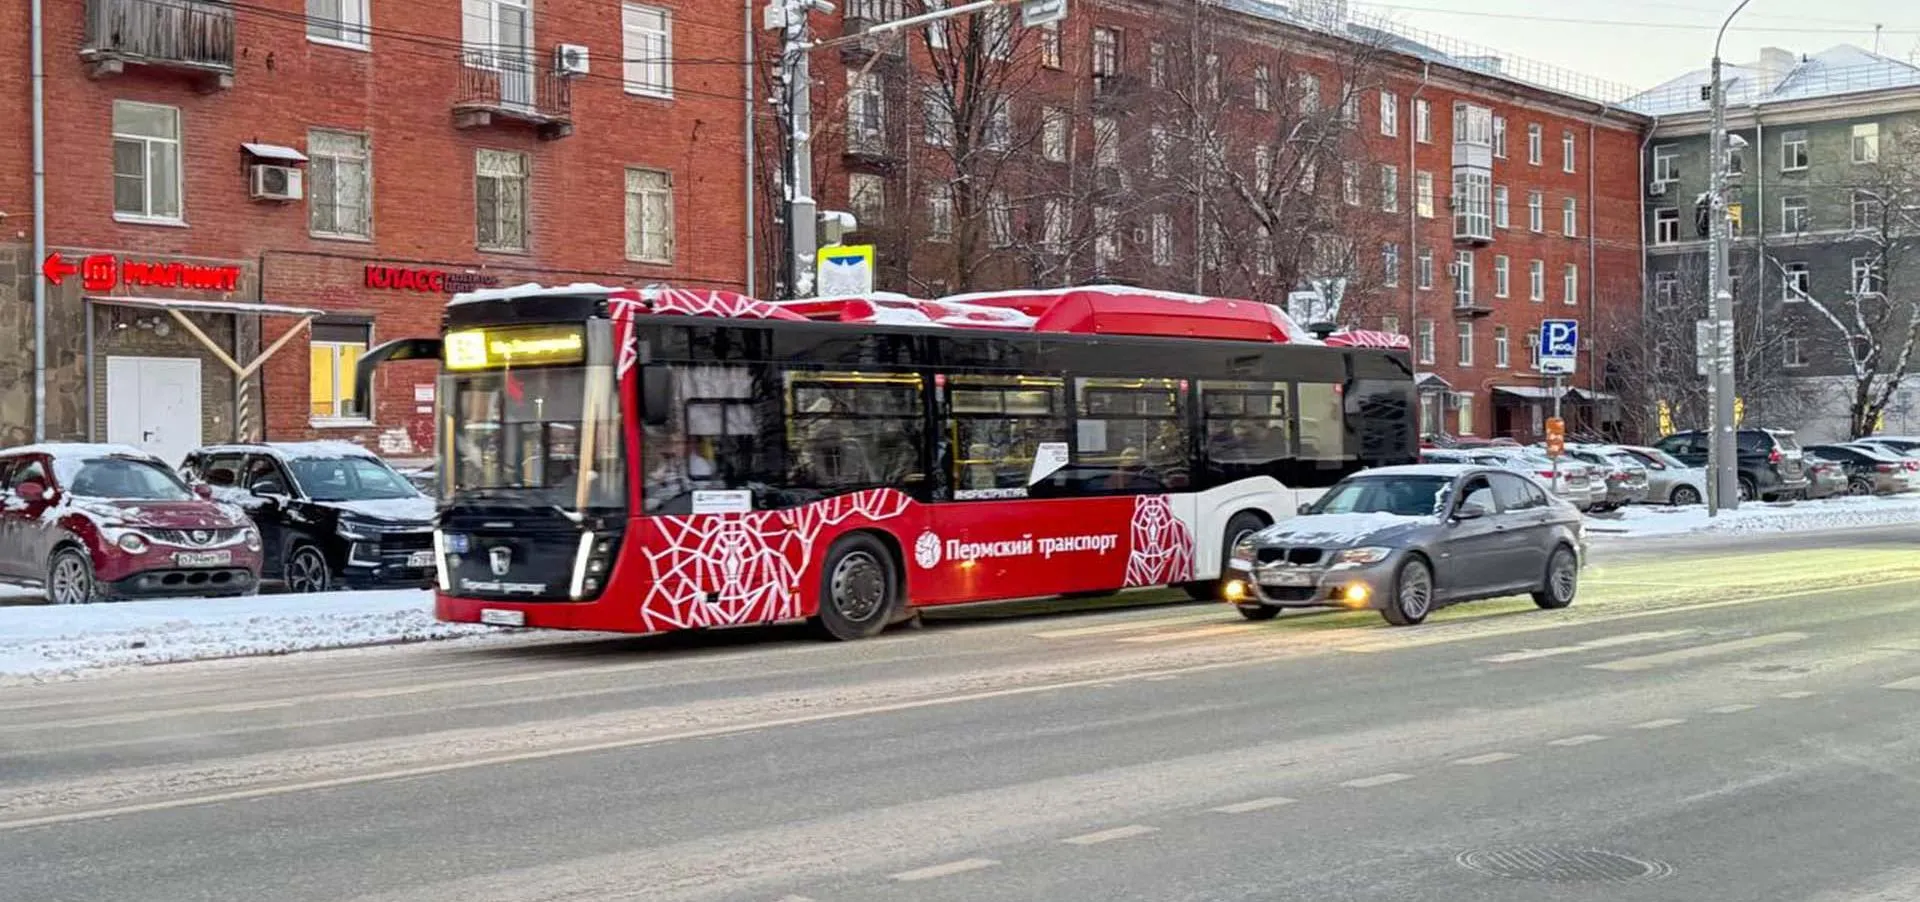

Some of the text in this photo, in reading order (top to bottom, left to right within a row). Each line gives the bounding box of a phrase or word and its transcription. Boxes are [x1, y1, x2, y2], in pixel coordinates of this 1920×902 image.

[123, 260, 240, 290] МАГНИТ
[365, 264, 444, 294] КЛАСС
[946, 533, 1119, 561] Пермский транспорт
